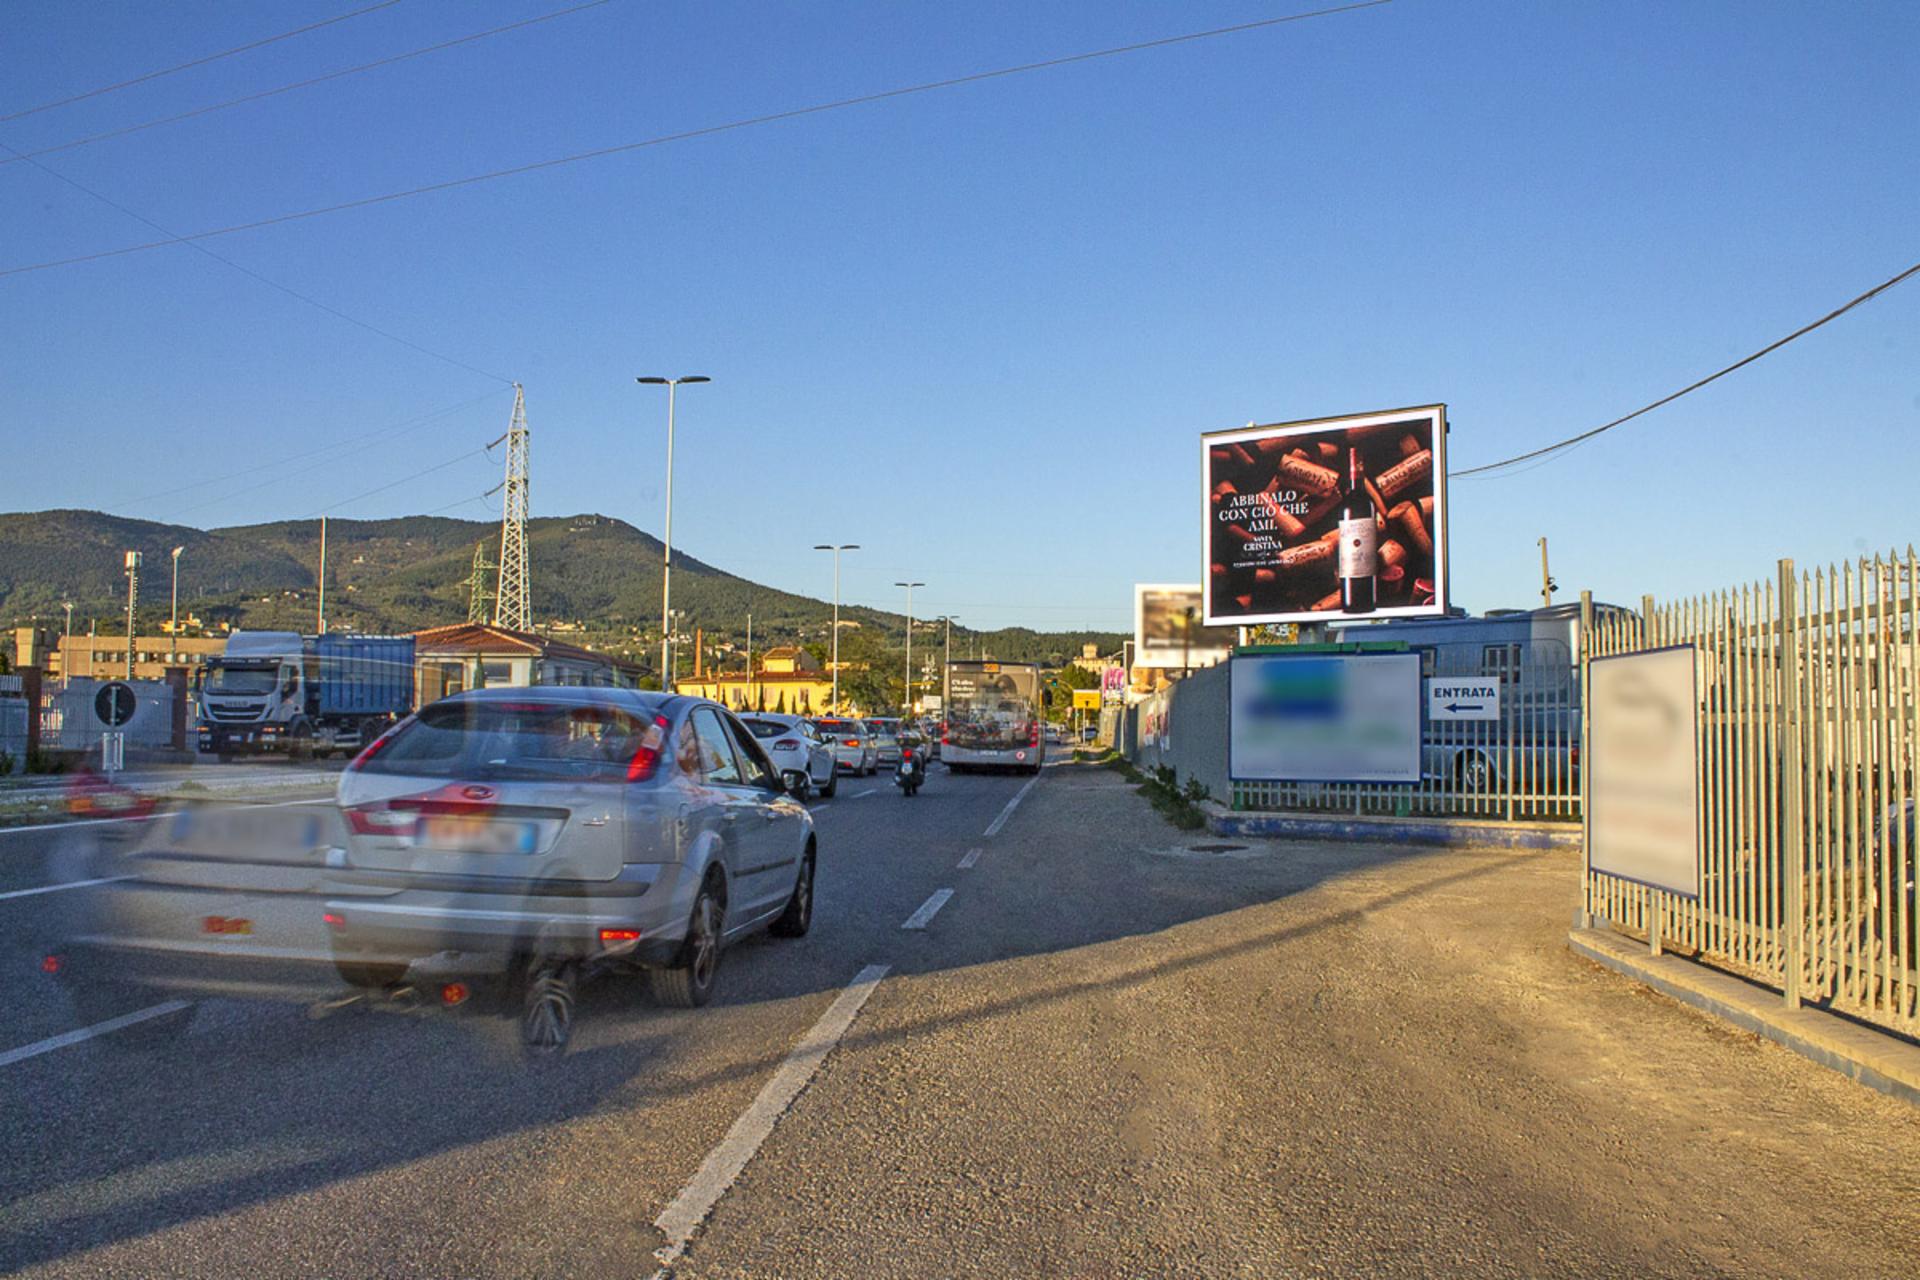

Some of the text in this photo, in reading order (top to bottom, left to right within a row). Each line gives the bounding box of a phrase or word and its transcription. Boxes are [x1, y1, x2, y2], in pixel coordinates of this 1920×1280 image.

[1230, 490, 1297, 507] ABBINALO
[1219, 508, 1248, 521] CON
[1280, 502, 1309, 515] CHE
[1243, 541, 1282, 551] CRISTINA
[1434, 687, 1496, 698] ENTRATA
